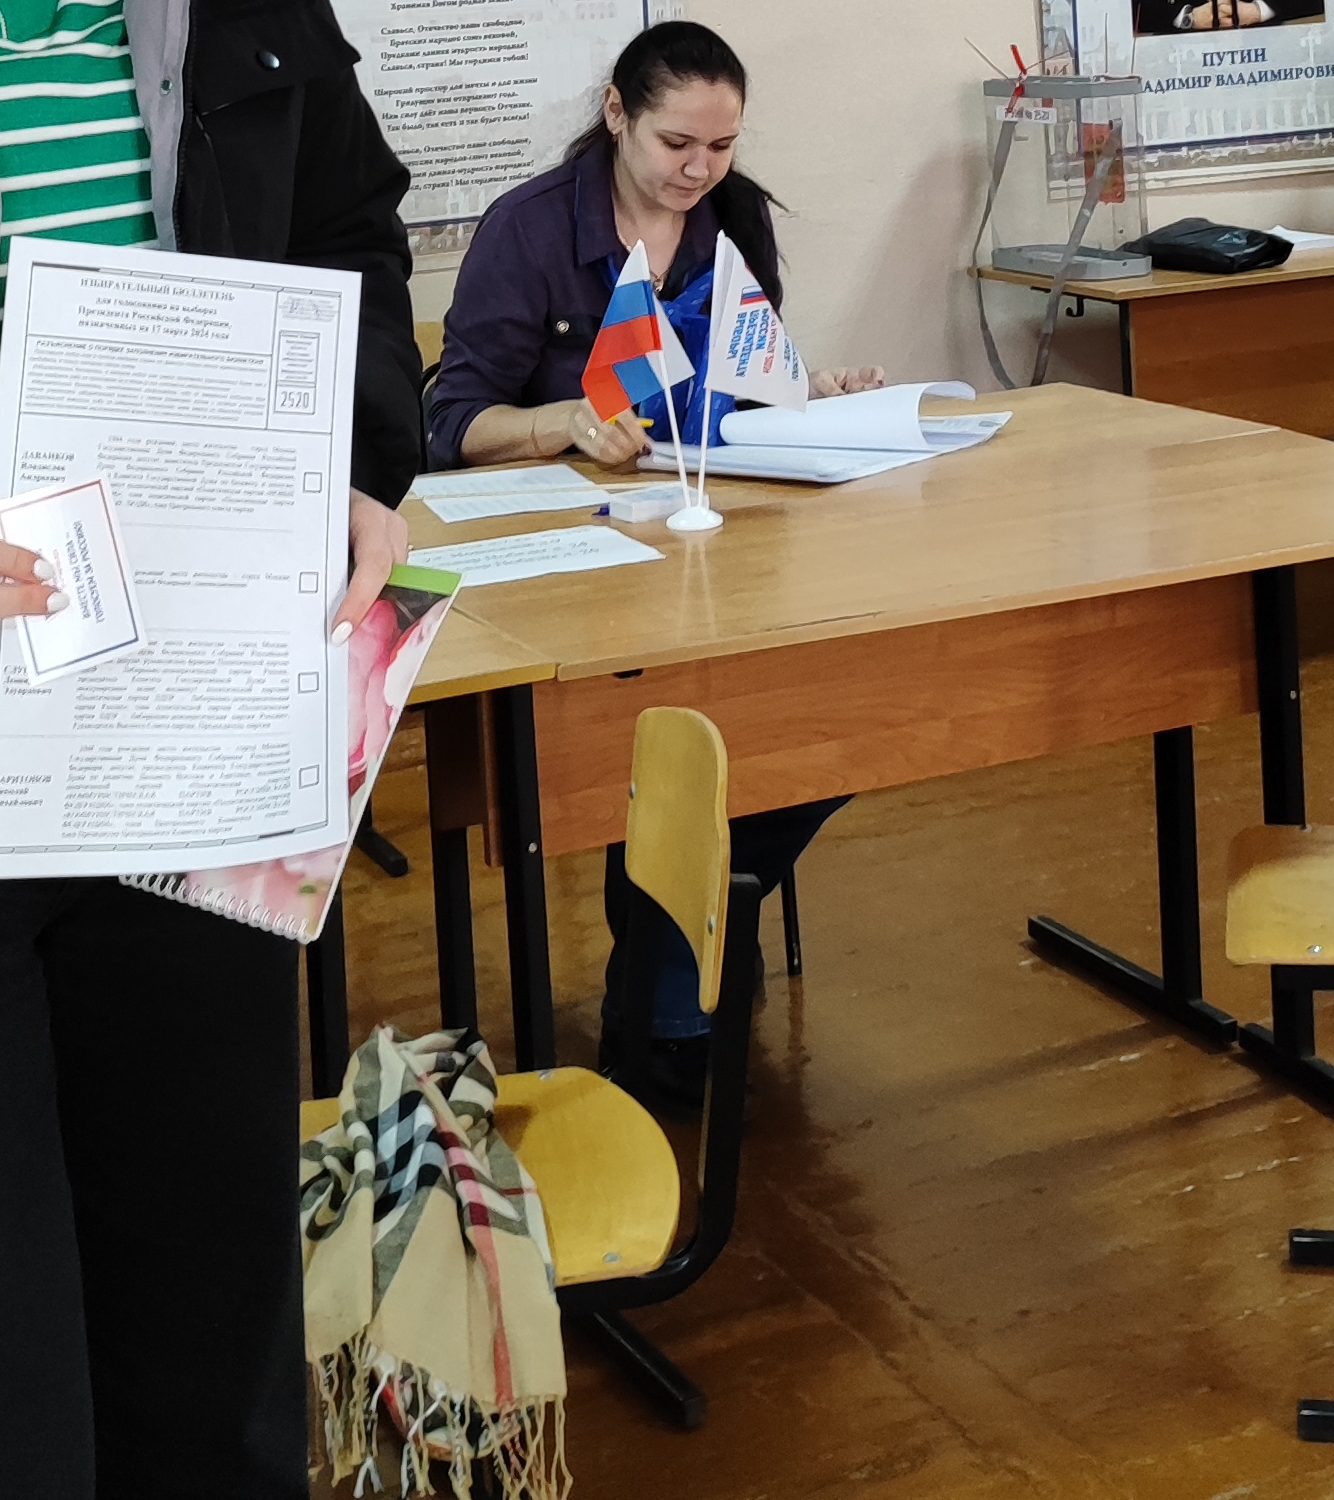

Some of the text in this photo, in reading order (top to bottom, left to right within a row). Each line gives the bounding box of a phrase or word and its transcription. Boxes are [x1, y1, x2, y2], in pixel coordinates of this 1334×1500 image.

[1202, 48, 1268, 67] ПУТИН
[1143, 75, 1212, 94] АДИМИР
[280, 391, 310, 409] 2520
